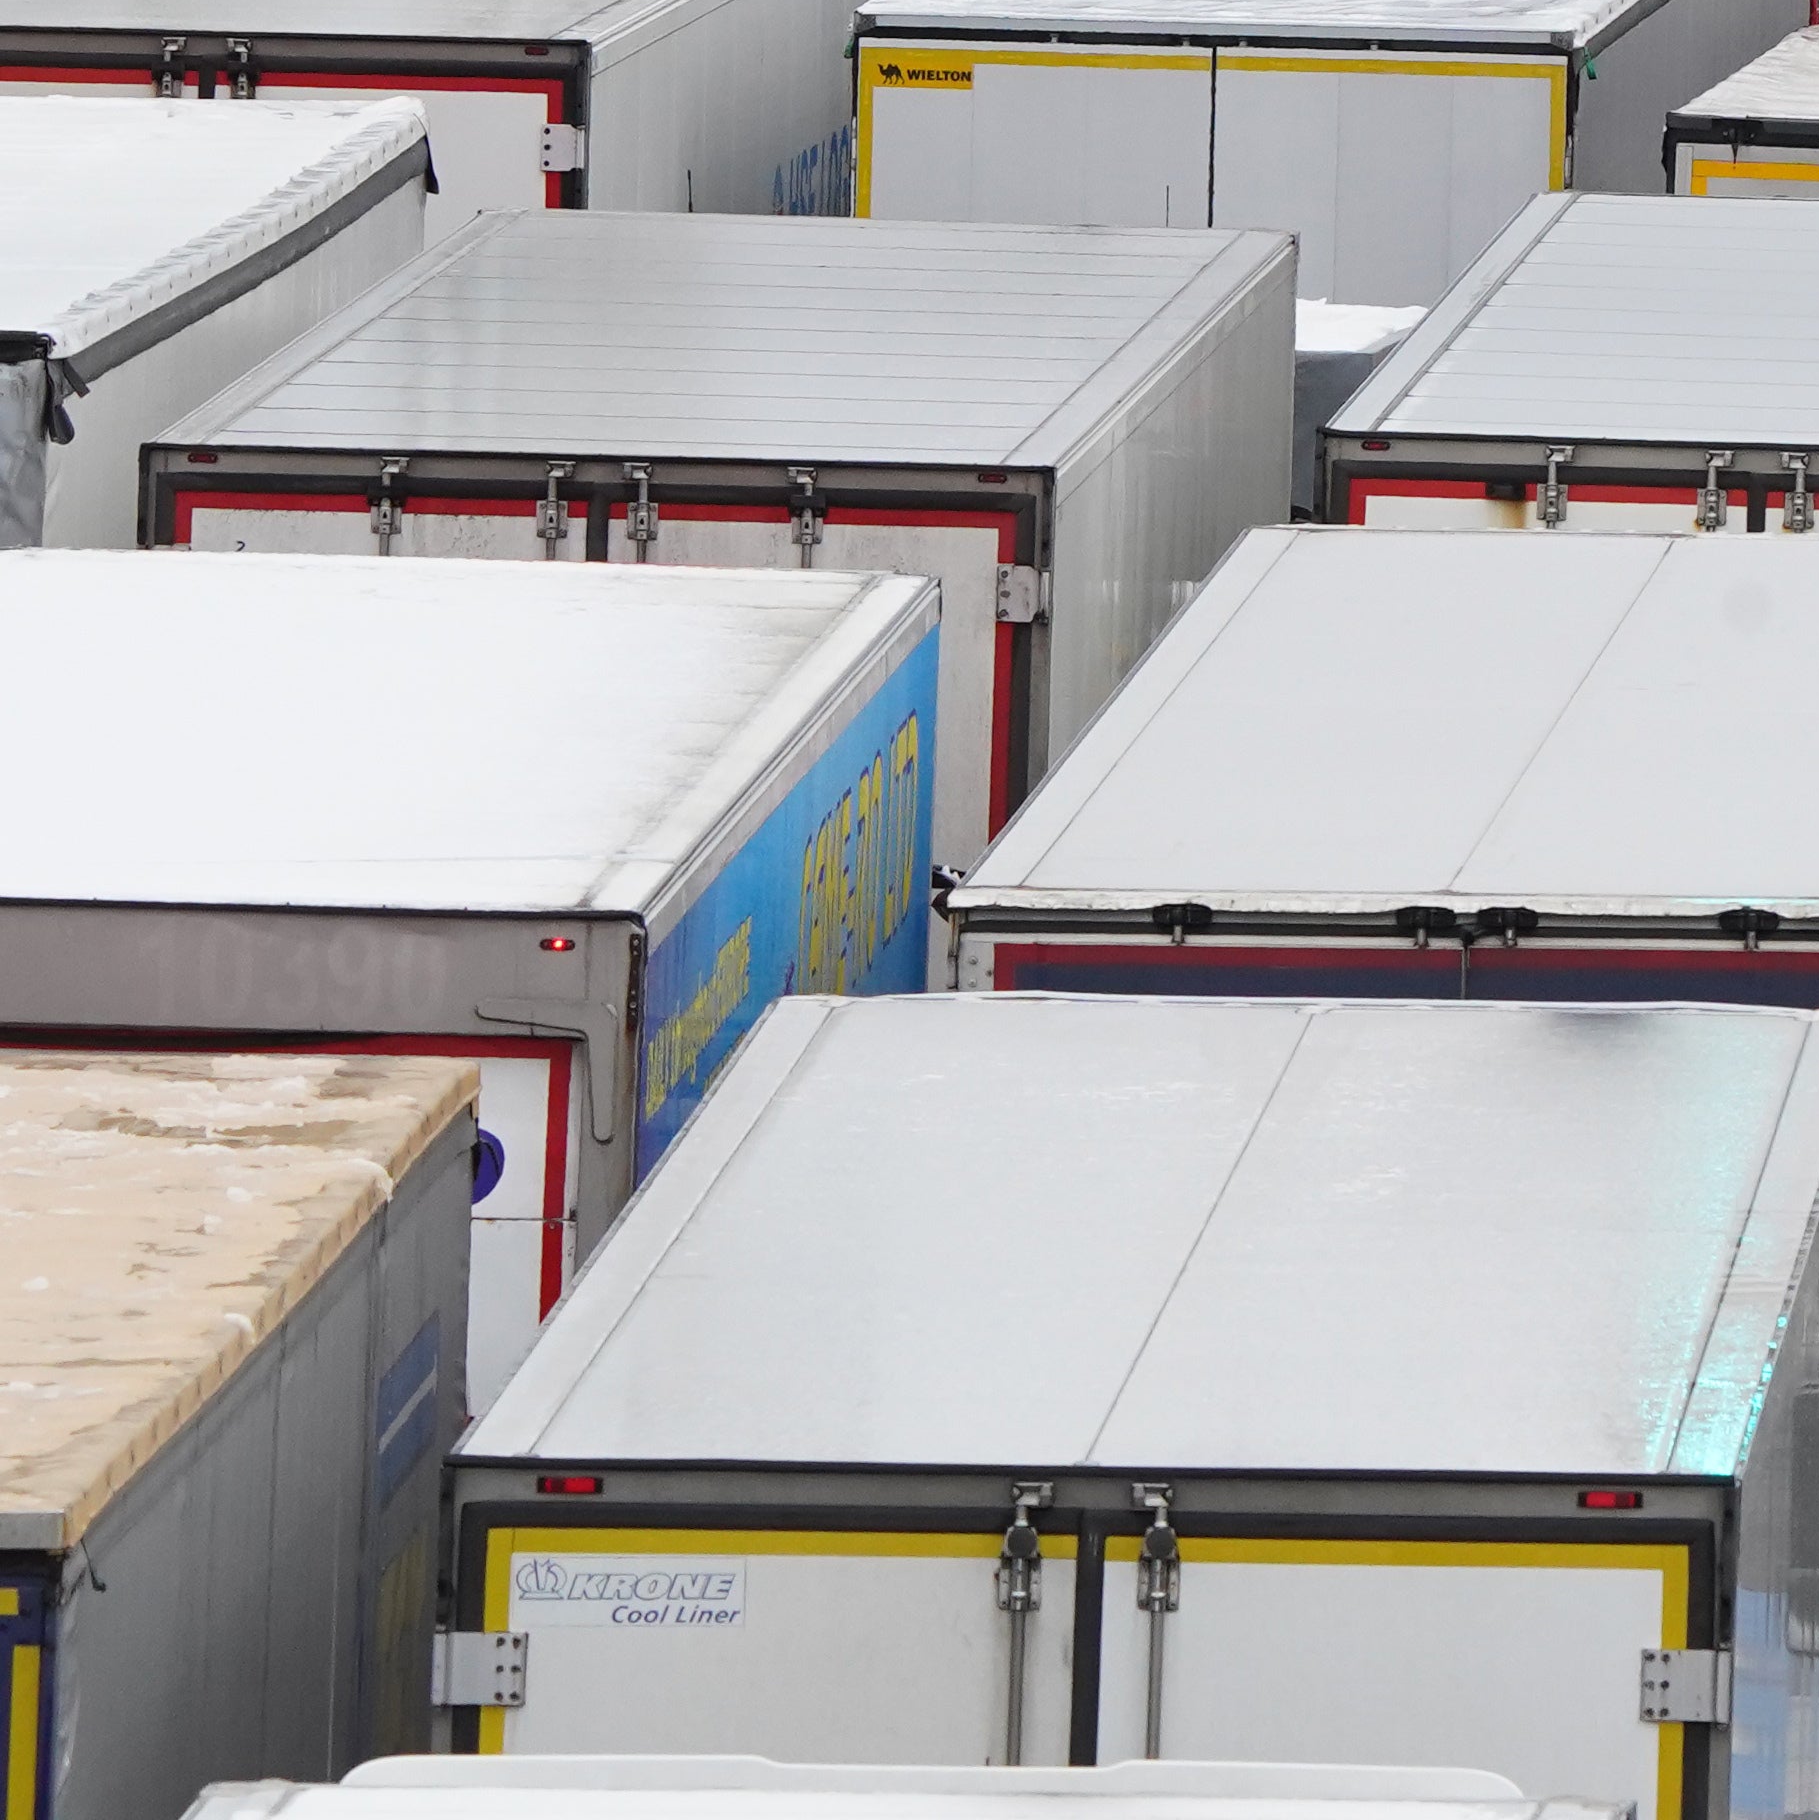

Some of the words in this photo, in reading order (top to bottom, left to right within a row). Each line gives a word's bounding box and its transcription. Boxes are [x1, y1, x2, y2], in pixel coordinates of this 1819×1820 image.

[907, 69, 972, 82] WIELTON
[567, 1572, 736, 1601] KRONE
[611, 1604, 670, 1625] Cool
[675, 1603, 741, 1625] Liner
